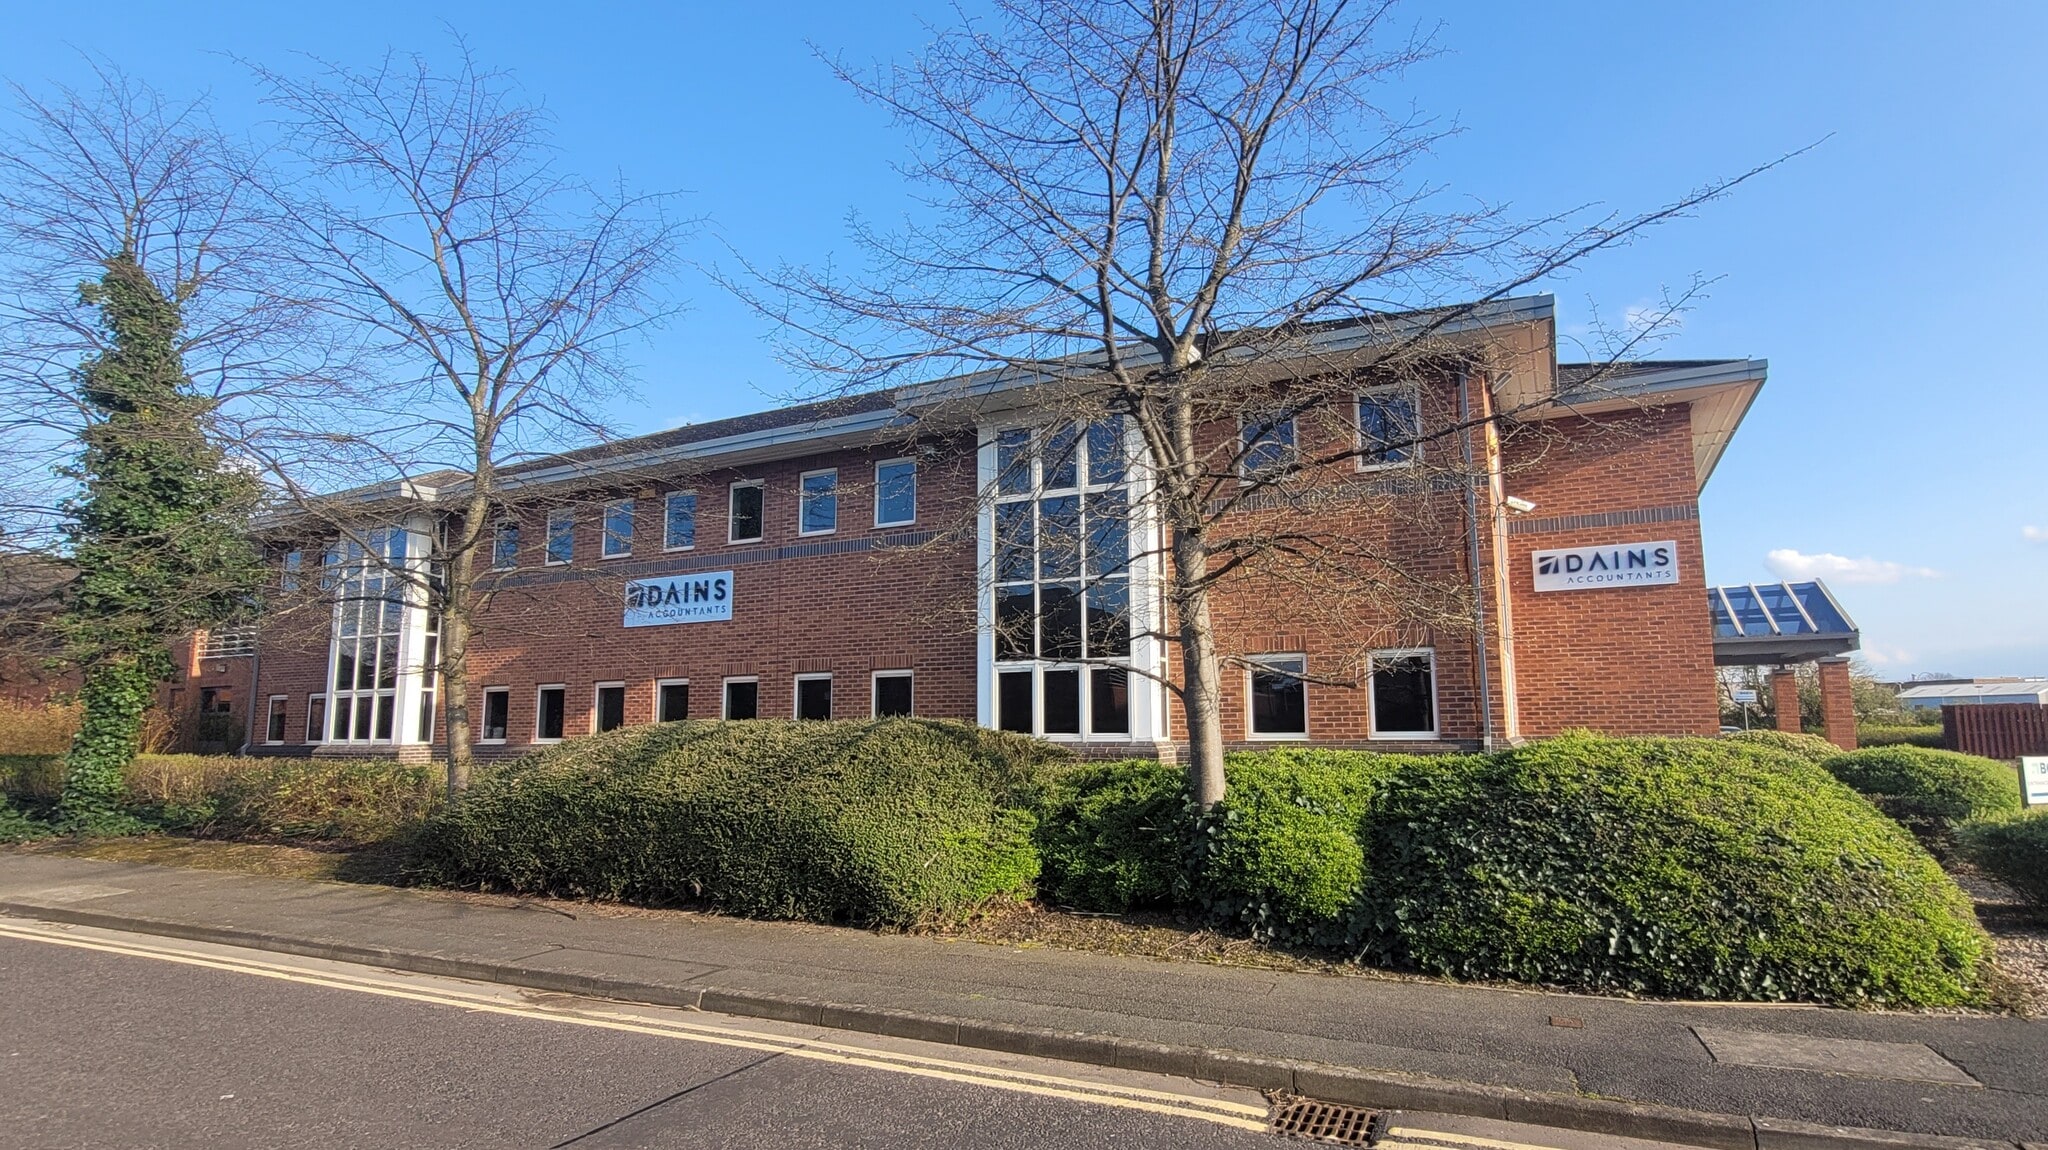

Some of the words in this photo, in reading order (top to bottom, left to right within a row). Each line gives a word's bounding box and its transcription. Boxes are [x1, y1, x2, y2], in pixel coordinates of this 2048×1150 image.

[1566, 548, 1669, 573] DAINS
[1567, 570, 1672, 584] ACCOUNTANTS
[648, 579, 726, 607] DAINS
[648, 605, 727, 619] ACCOUNTANTS
[2040, 762, 2048, 774] B
